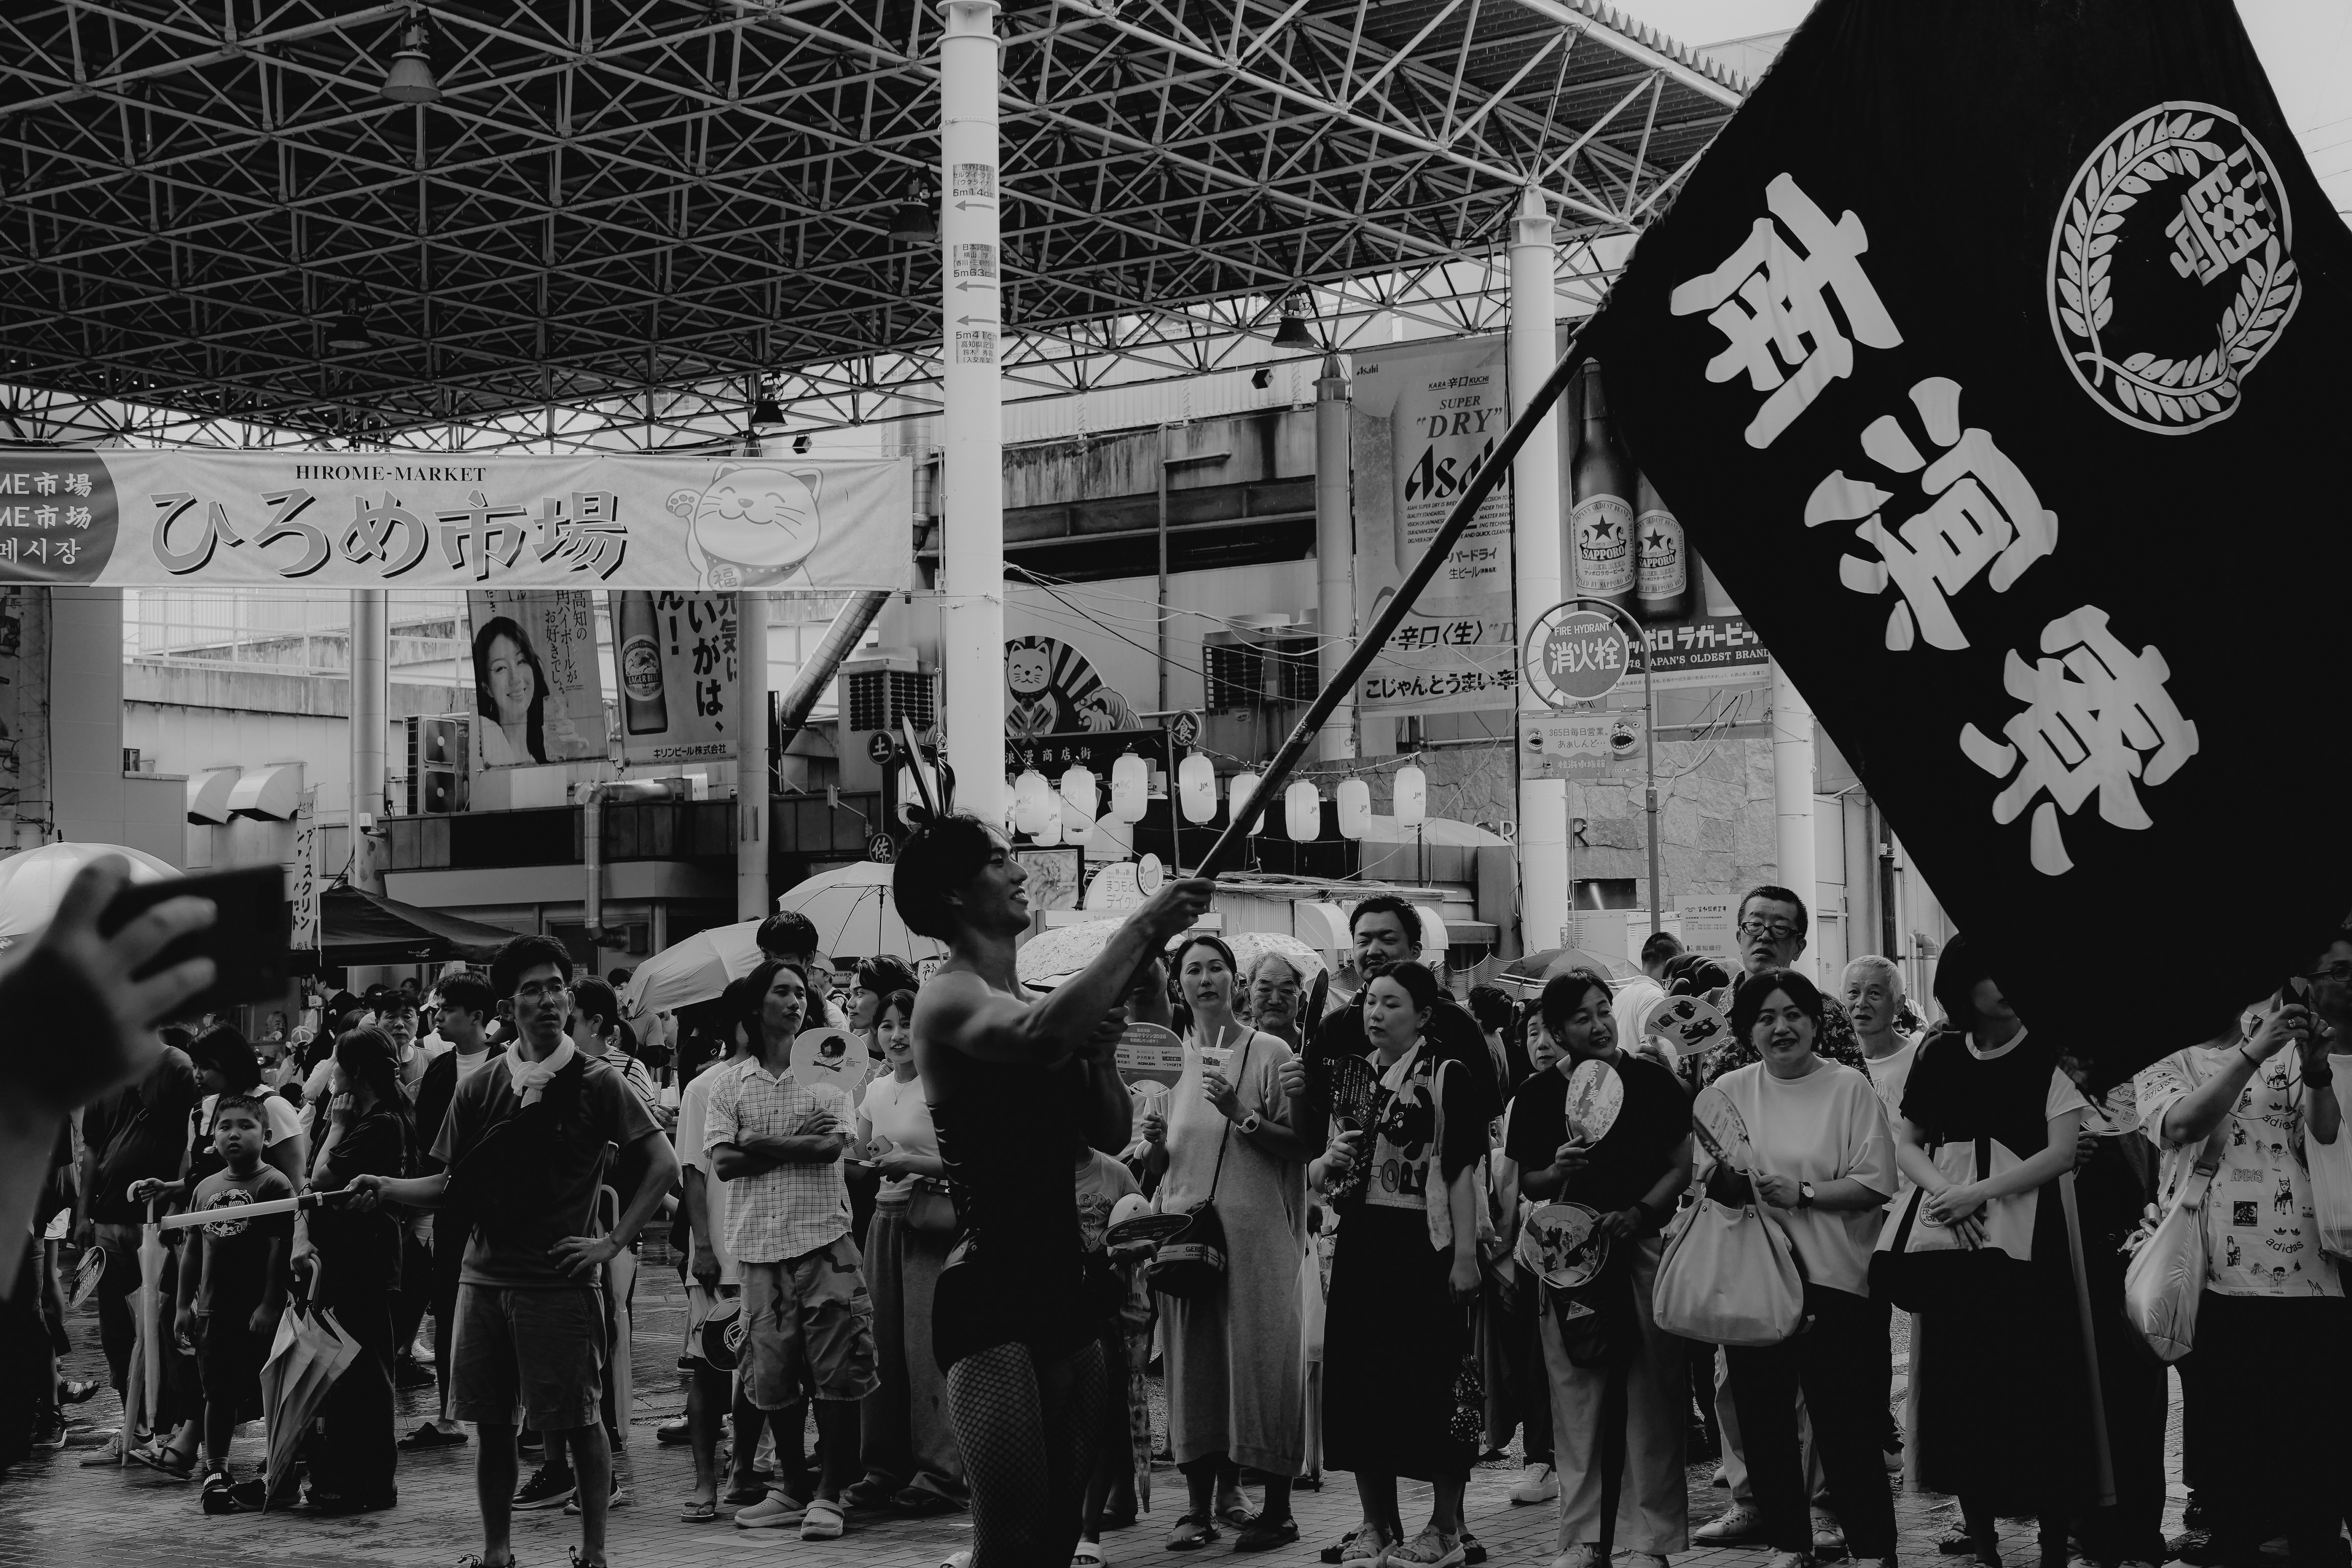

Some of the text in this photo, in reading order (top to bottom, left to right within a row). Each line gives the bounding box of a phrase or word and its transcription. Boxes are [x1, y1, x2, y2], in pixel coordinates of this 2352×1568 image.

[953, 188, 995, 199] 6m14cm
[953, 268, 996, 279] 5m63cm
[956, 331, 997, 340] 5m41cm
[1357, 364, 1378, 375] Asahi
[1429, 381, 1446, 389] KARA
[1469, 375, 1489, 384] KUCHI
[1439, 396, 1481, 410] SUPER
[295, 464, 486, 482] HIROME-MARKET
[1592, 501, 1612, 510] OLDEST
[1614, 505, 1629, 518] BRAND
[1647, 516, 1663, 524] OLDEST
[148, 487, 628, 581] ひろめ市場
[1447, 547, 1497, 563] パードライ
[1583, 545, 1625, 560] SAPPORO
[714, 568, 738, 590] 福
[1449, 566, 1480, 580] 生ビール
[1600, 578, 1623, 588] SAPPORO
[1652, 582, 1674, 592] SAPPORO
[573, 590, 587, 640] 高知の
[1554, 621, 1611, 636] FIRE HYDRANT
[1549, 636, 1621, 675] 消火栓
[1650, 654, 1685, 667] APAN'S
[1690, 651, 1732, 663] OLDEST
[1735, 648, 1770, 659] BRAND
[628, 674, 647, 684] LAGER
[1174, 715, 1195, 741] 食
[1549, 727, 1608, 737] 365日毎日営業。
[653, 743, 726, 758] キリンビール株式会社
[873, 737, 889, 756] 土
[1006, 746, 1091, 765] 浪漫商店街
[1557, 759, 1606, 769] 桂浜水族館
[872, 837, 891, 863] 佐
[1106, 880, 1135, 892] まつもと
[2265, 1238, 2304, 1254] adidas
